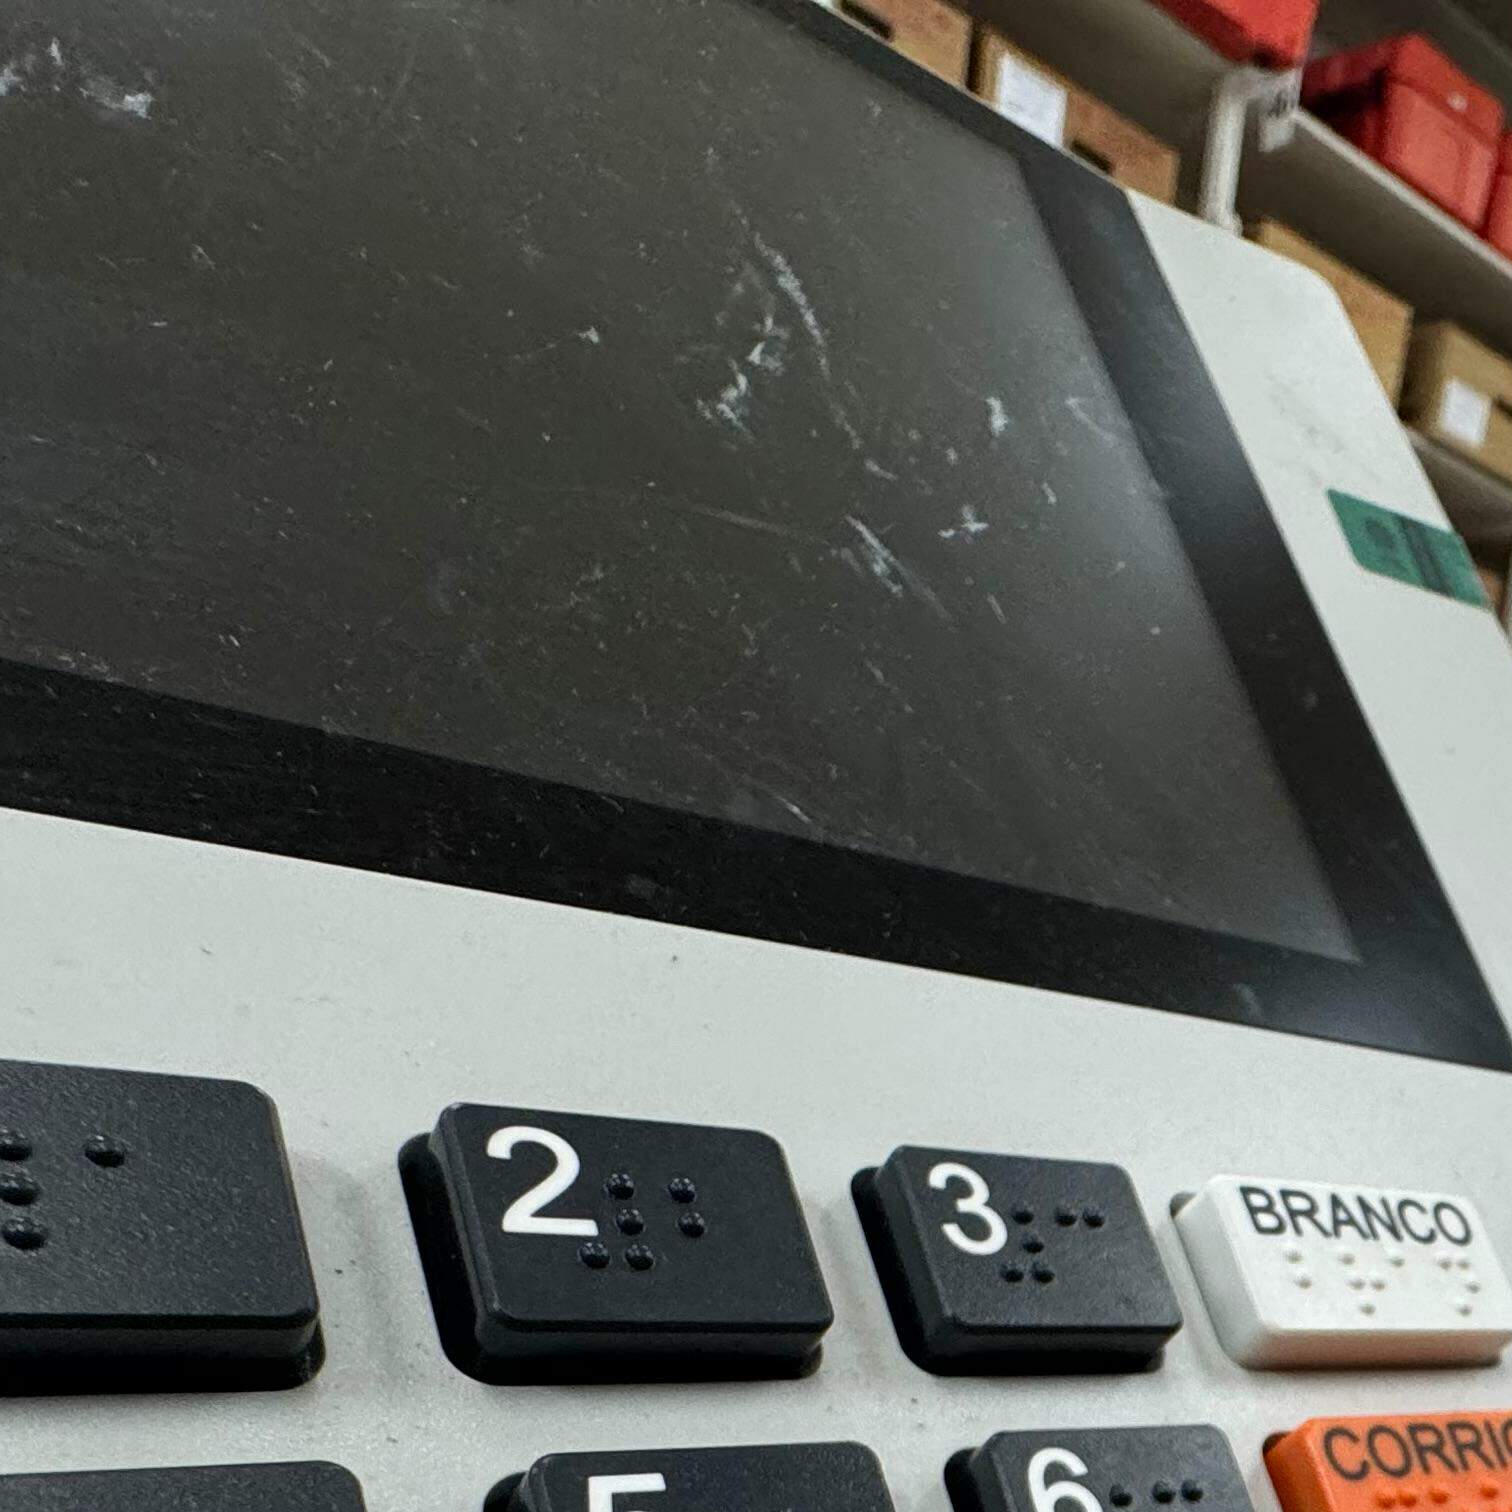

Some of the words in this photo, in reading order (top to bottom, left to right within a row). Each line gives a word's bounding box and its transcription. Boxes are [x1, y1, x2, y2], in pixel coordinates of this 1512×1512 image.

[487, 1126, 598, 1236] 2
[928, 1162, 1008, 1256] 3
[1239, 1185, 1473, 1246] BRANCO
